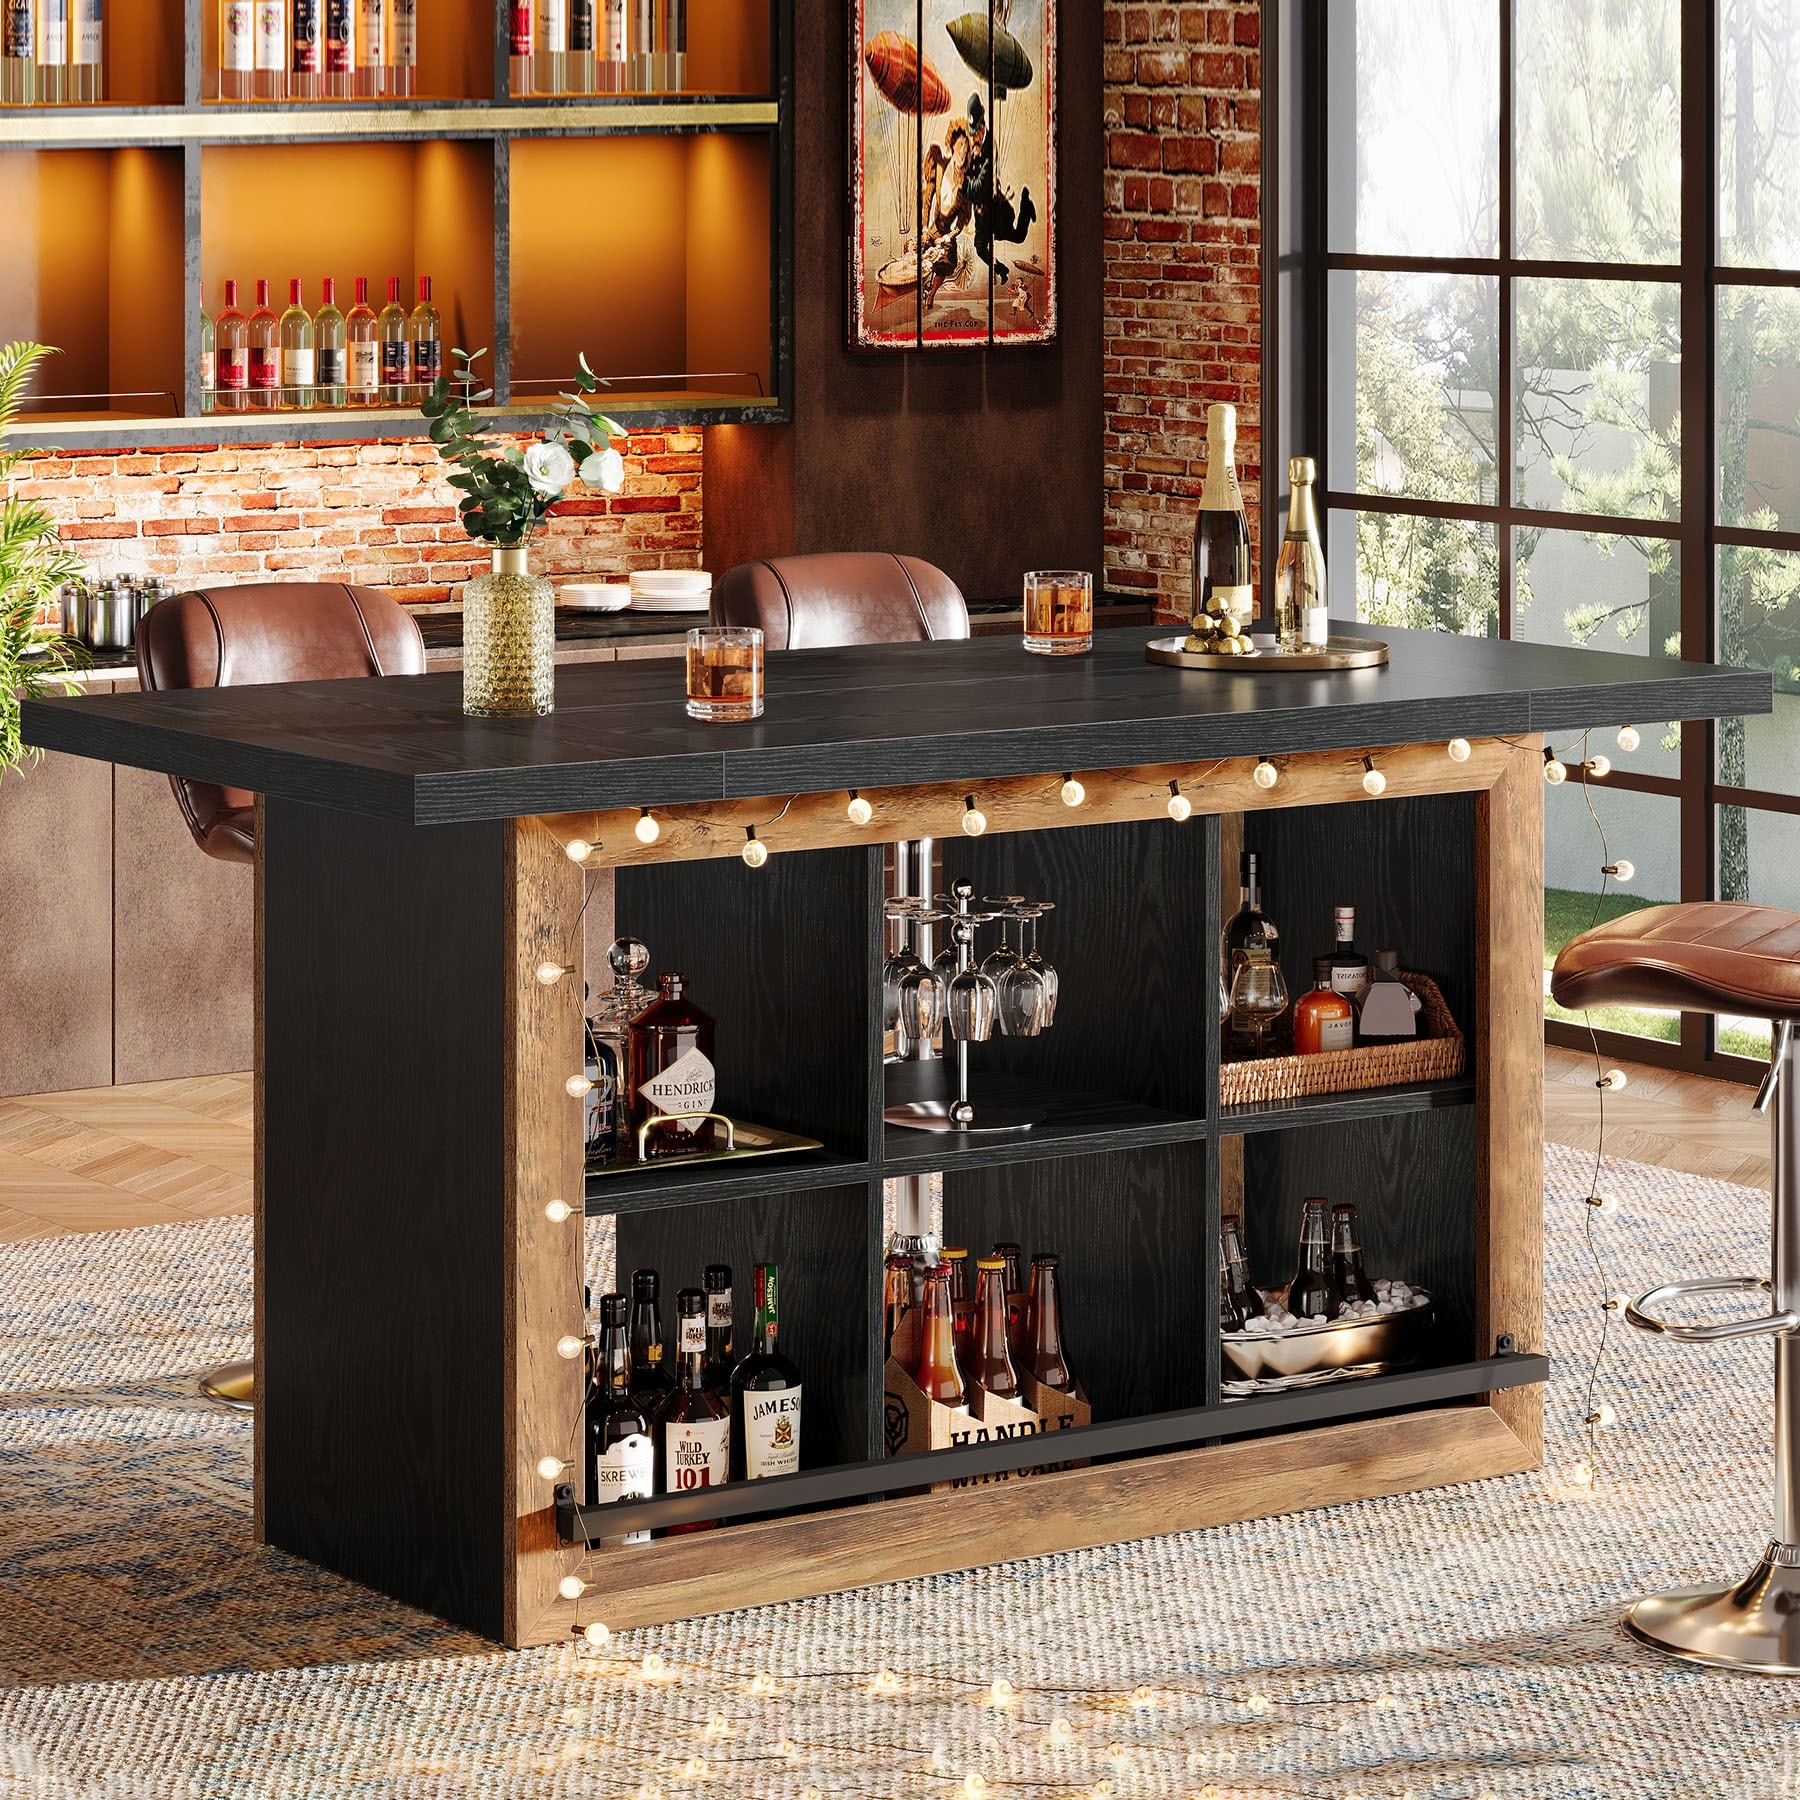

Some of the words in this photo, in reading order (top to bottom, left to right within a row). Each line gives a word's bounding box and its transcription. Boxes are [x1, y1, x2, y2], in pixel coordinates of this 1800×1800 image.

[684, 1100, 703, 1109] GIN
[766, 1276, 775, 1314] JAMESON
[679, 1440, 702, 1453] WILD
[675, 1450, 711, 1466] TURKEY
[675, 1466, 711, 1490] 101
